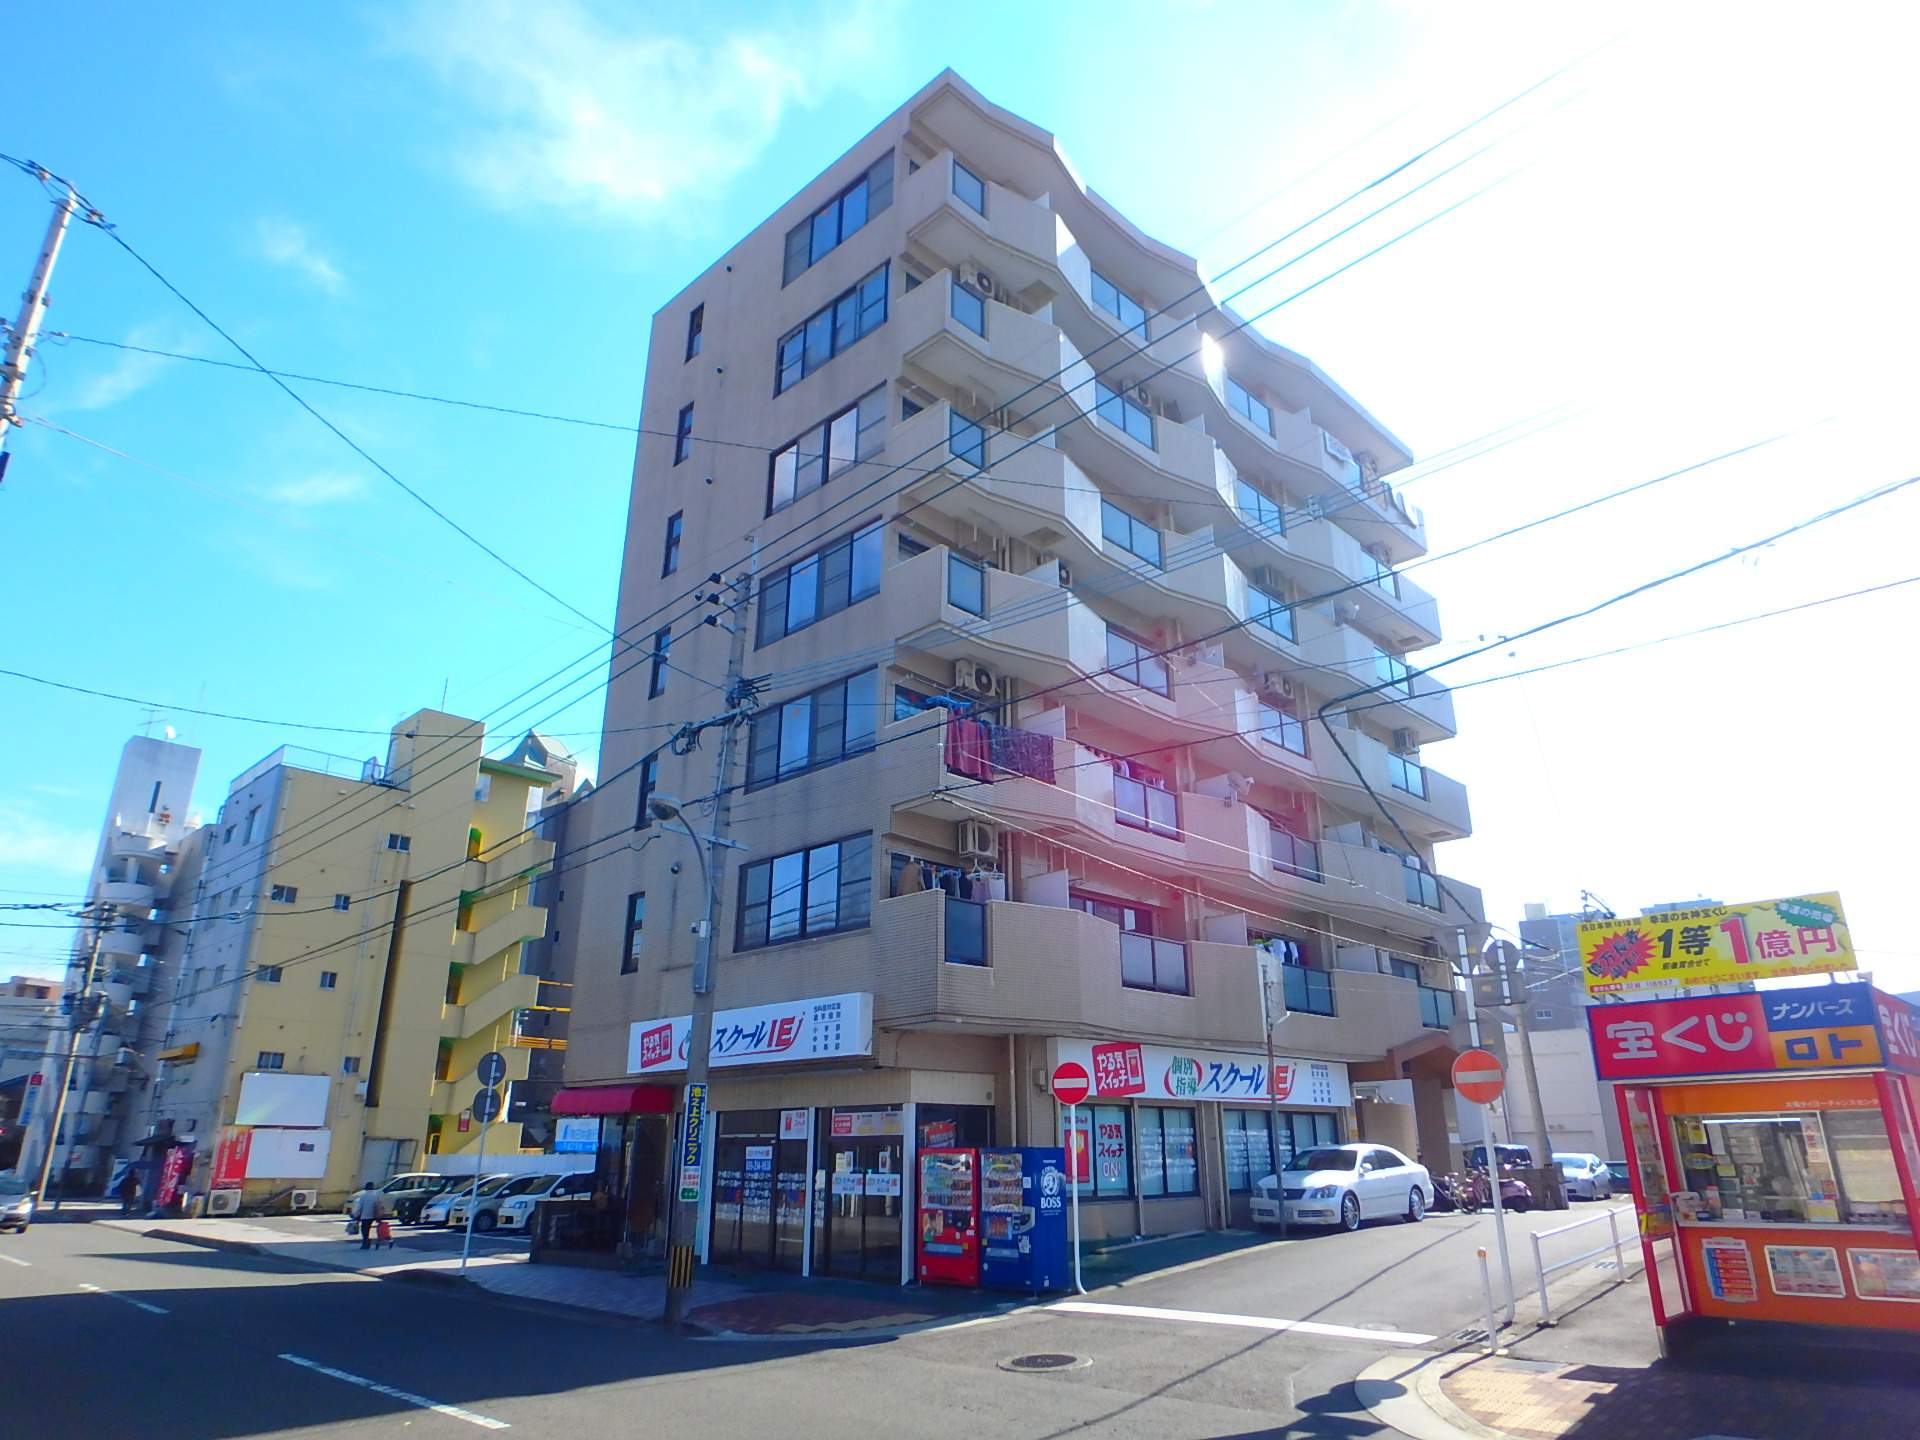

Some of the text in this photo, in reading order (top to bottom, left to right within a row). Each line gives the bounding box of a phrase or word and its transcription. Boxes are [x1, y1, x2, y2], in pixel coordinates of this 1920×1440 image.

[1657, 924, 1712, 958] 1等
[1772, 998, 1854, 1021] ナンバーズ
[643, 1033, 661, 1050] やる気
[708, 1014, 797, 1054] スクールIE
[1606, 1013, 1753, 1060] 宝くじ
[642, 1046, 662, 1063] スイッチ
[1785, 1032, 1863, 1061] ロト
[1097, 1051, 1125, 1072] やる気
[1171, 1056, 1193, 1076] 個別
[1097, 1069, 1128, 1091] スイッチ
[1176, 1076, 1199, 1096] 指導
[1098, 1122, 1123, 1140] やる気
[1098, 1142, 1125, 1158] スイッチ
[1040, 1196, 1062, 1209] BOSS
